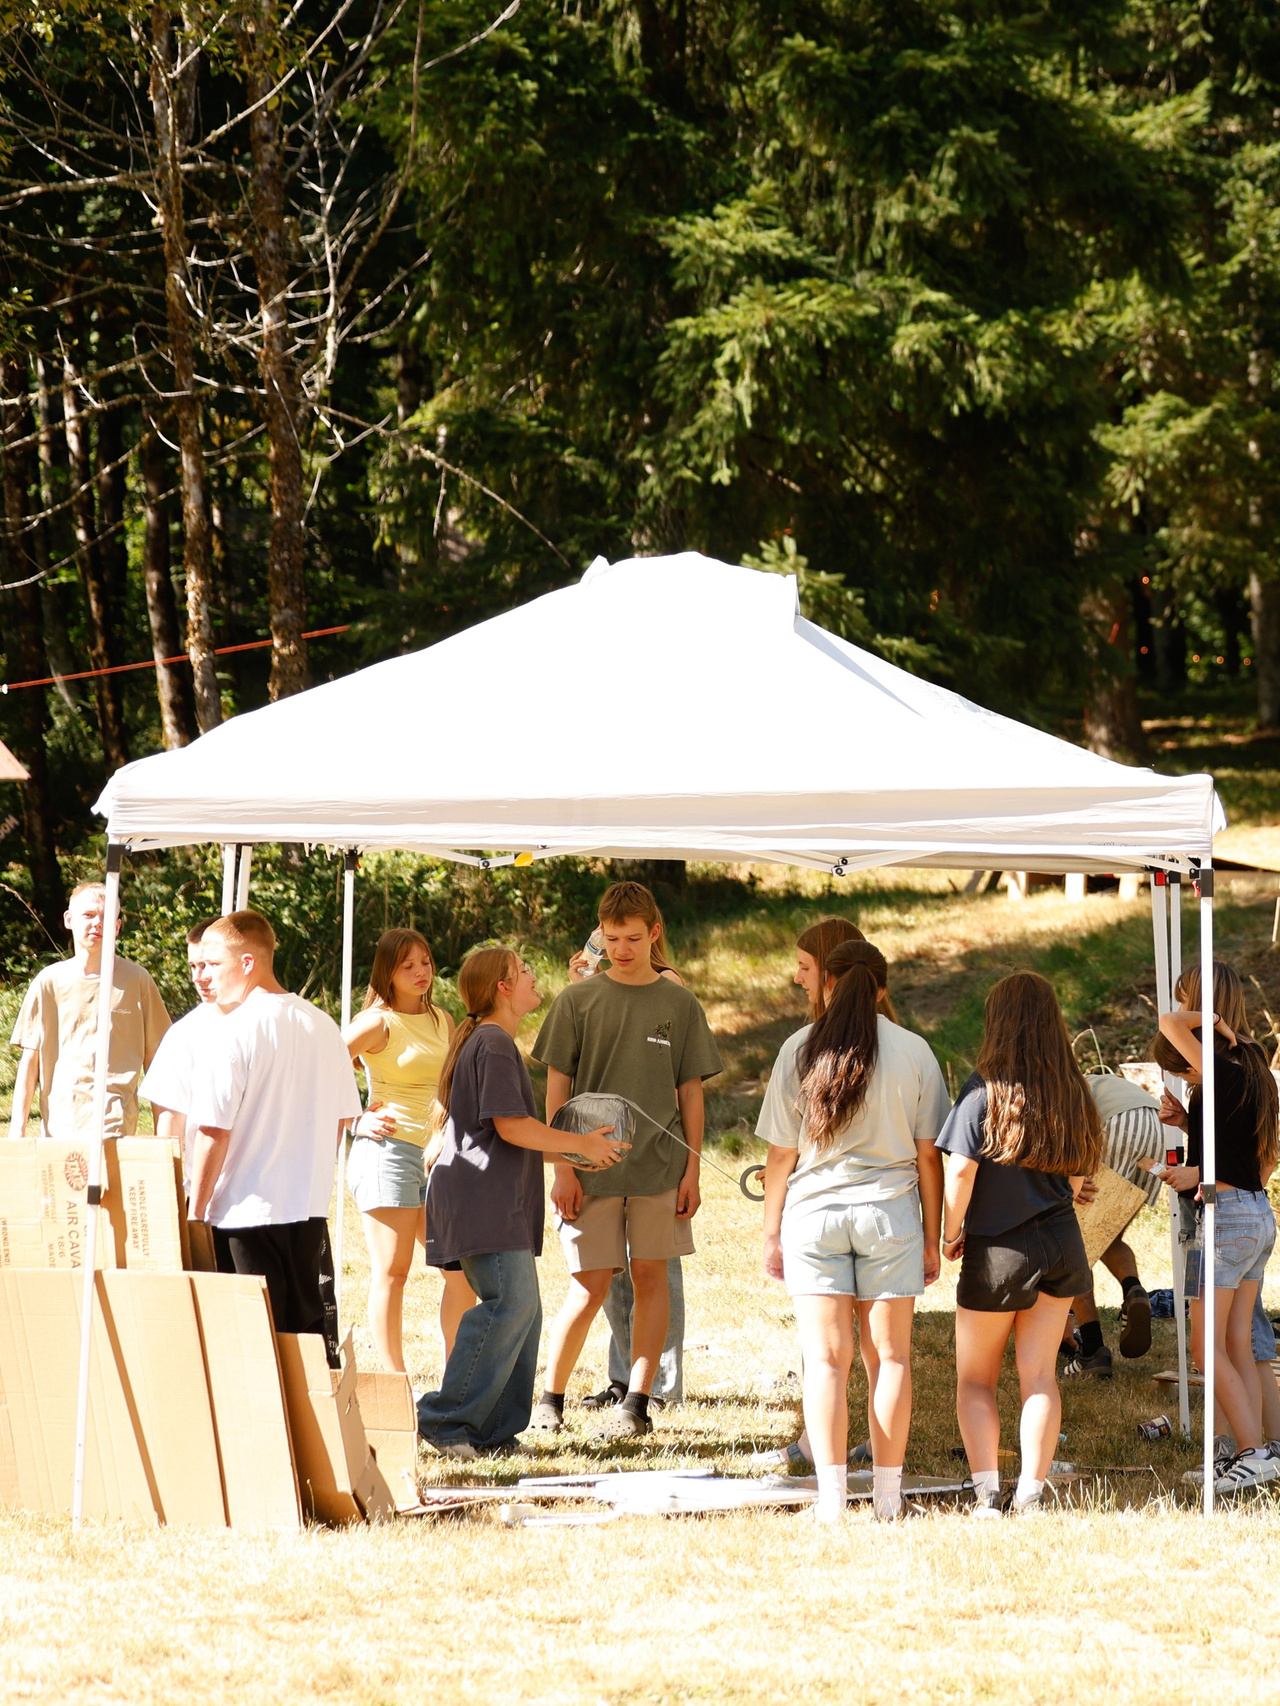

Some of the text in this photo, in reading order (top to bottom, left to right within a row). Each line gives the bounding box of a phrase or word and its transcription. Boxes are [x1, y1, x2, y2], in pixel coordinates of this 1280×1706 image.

[66, 1200, 78, 1226] AIR
[128, 1186, 140, 1250] KEEP FIRE AWAY
[138, 1179, 150, 1258] HANDLE CAREFULLY
[48, 1243, 56, 1268] MADE
